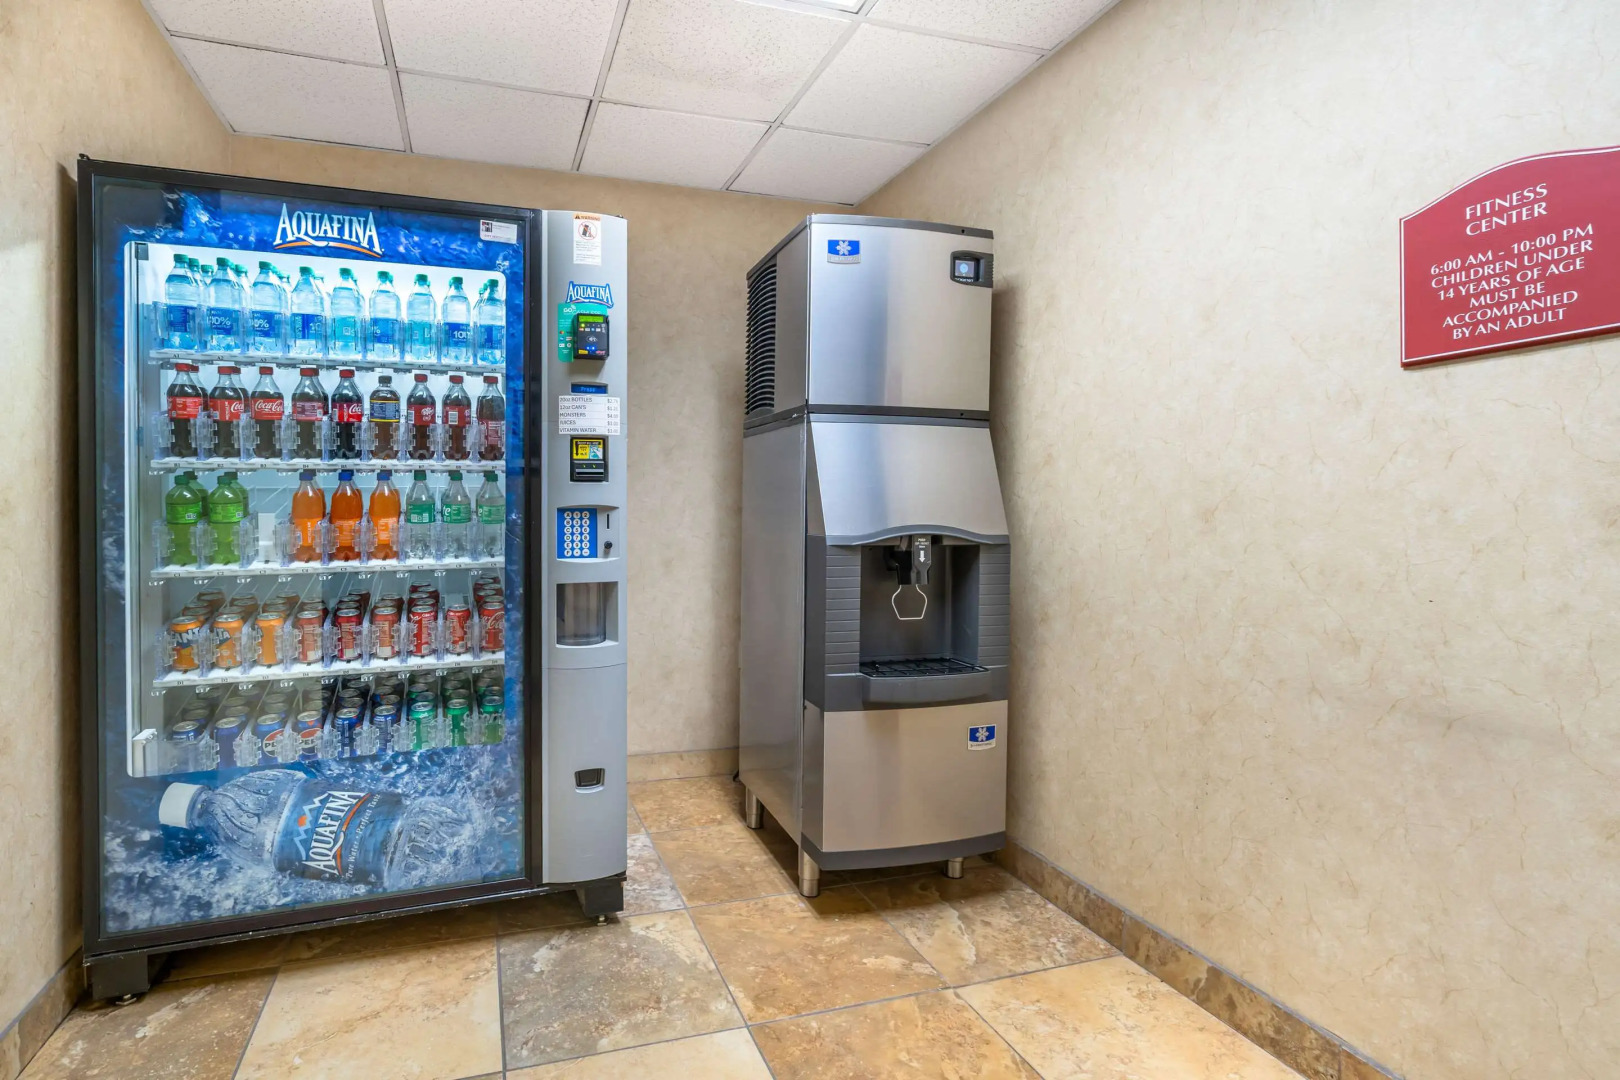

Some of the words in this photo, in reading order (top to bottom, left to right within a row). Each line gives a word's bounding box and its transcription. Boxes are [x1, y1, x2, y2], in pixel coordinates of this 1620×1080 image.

[1465, 183, 1548, 220] FITNESS
[1465, 202, 1548, 236] CENTER
[273, 202, 384, 256] AQUAFINA
[1430, 258, 1461, 275] 6:00
[1465, 250, 1493, 267] AM
[1511, 233, 1556, 254] 10:00
[1563, 223, 1593, 241] PM
[1431, 258, 1518, 288] CHILDREN
[1524, 239, 1593, 266] UNDER
[1437, 289, 1455, 301] 14
[1458, 275, 1511, 296] YEARS
[1516, 267, 1542, 283] OF
[1545, 257, 1585, 276] AGE
[566, 282, 613, 308] AQUAFINA
[1442, 290, 1579, 328] ACCOMPANIED
[1469, 287, 1519, 308] MUST
[1524, 281, 1546, 296] BE
[1452, 327, 1472, 340] BY
[1474, 321, 1500, 336] AN
[1505, 307, 1567, 331] ADULT
[302, 791, 365, 874] AQUAFINA
[348, 841, 359, 862] Water
[356, 809, 373, 834] Perfect
